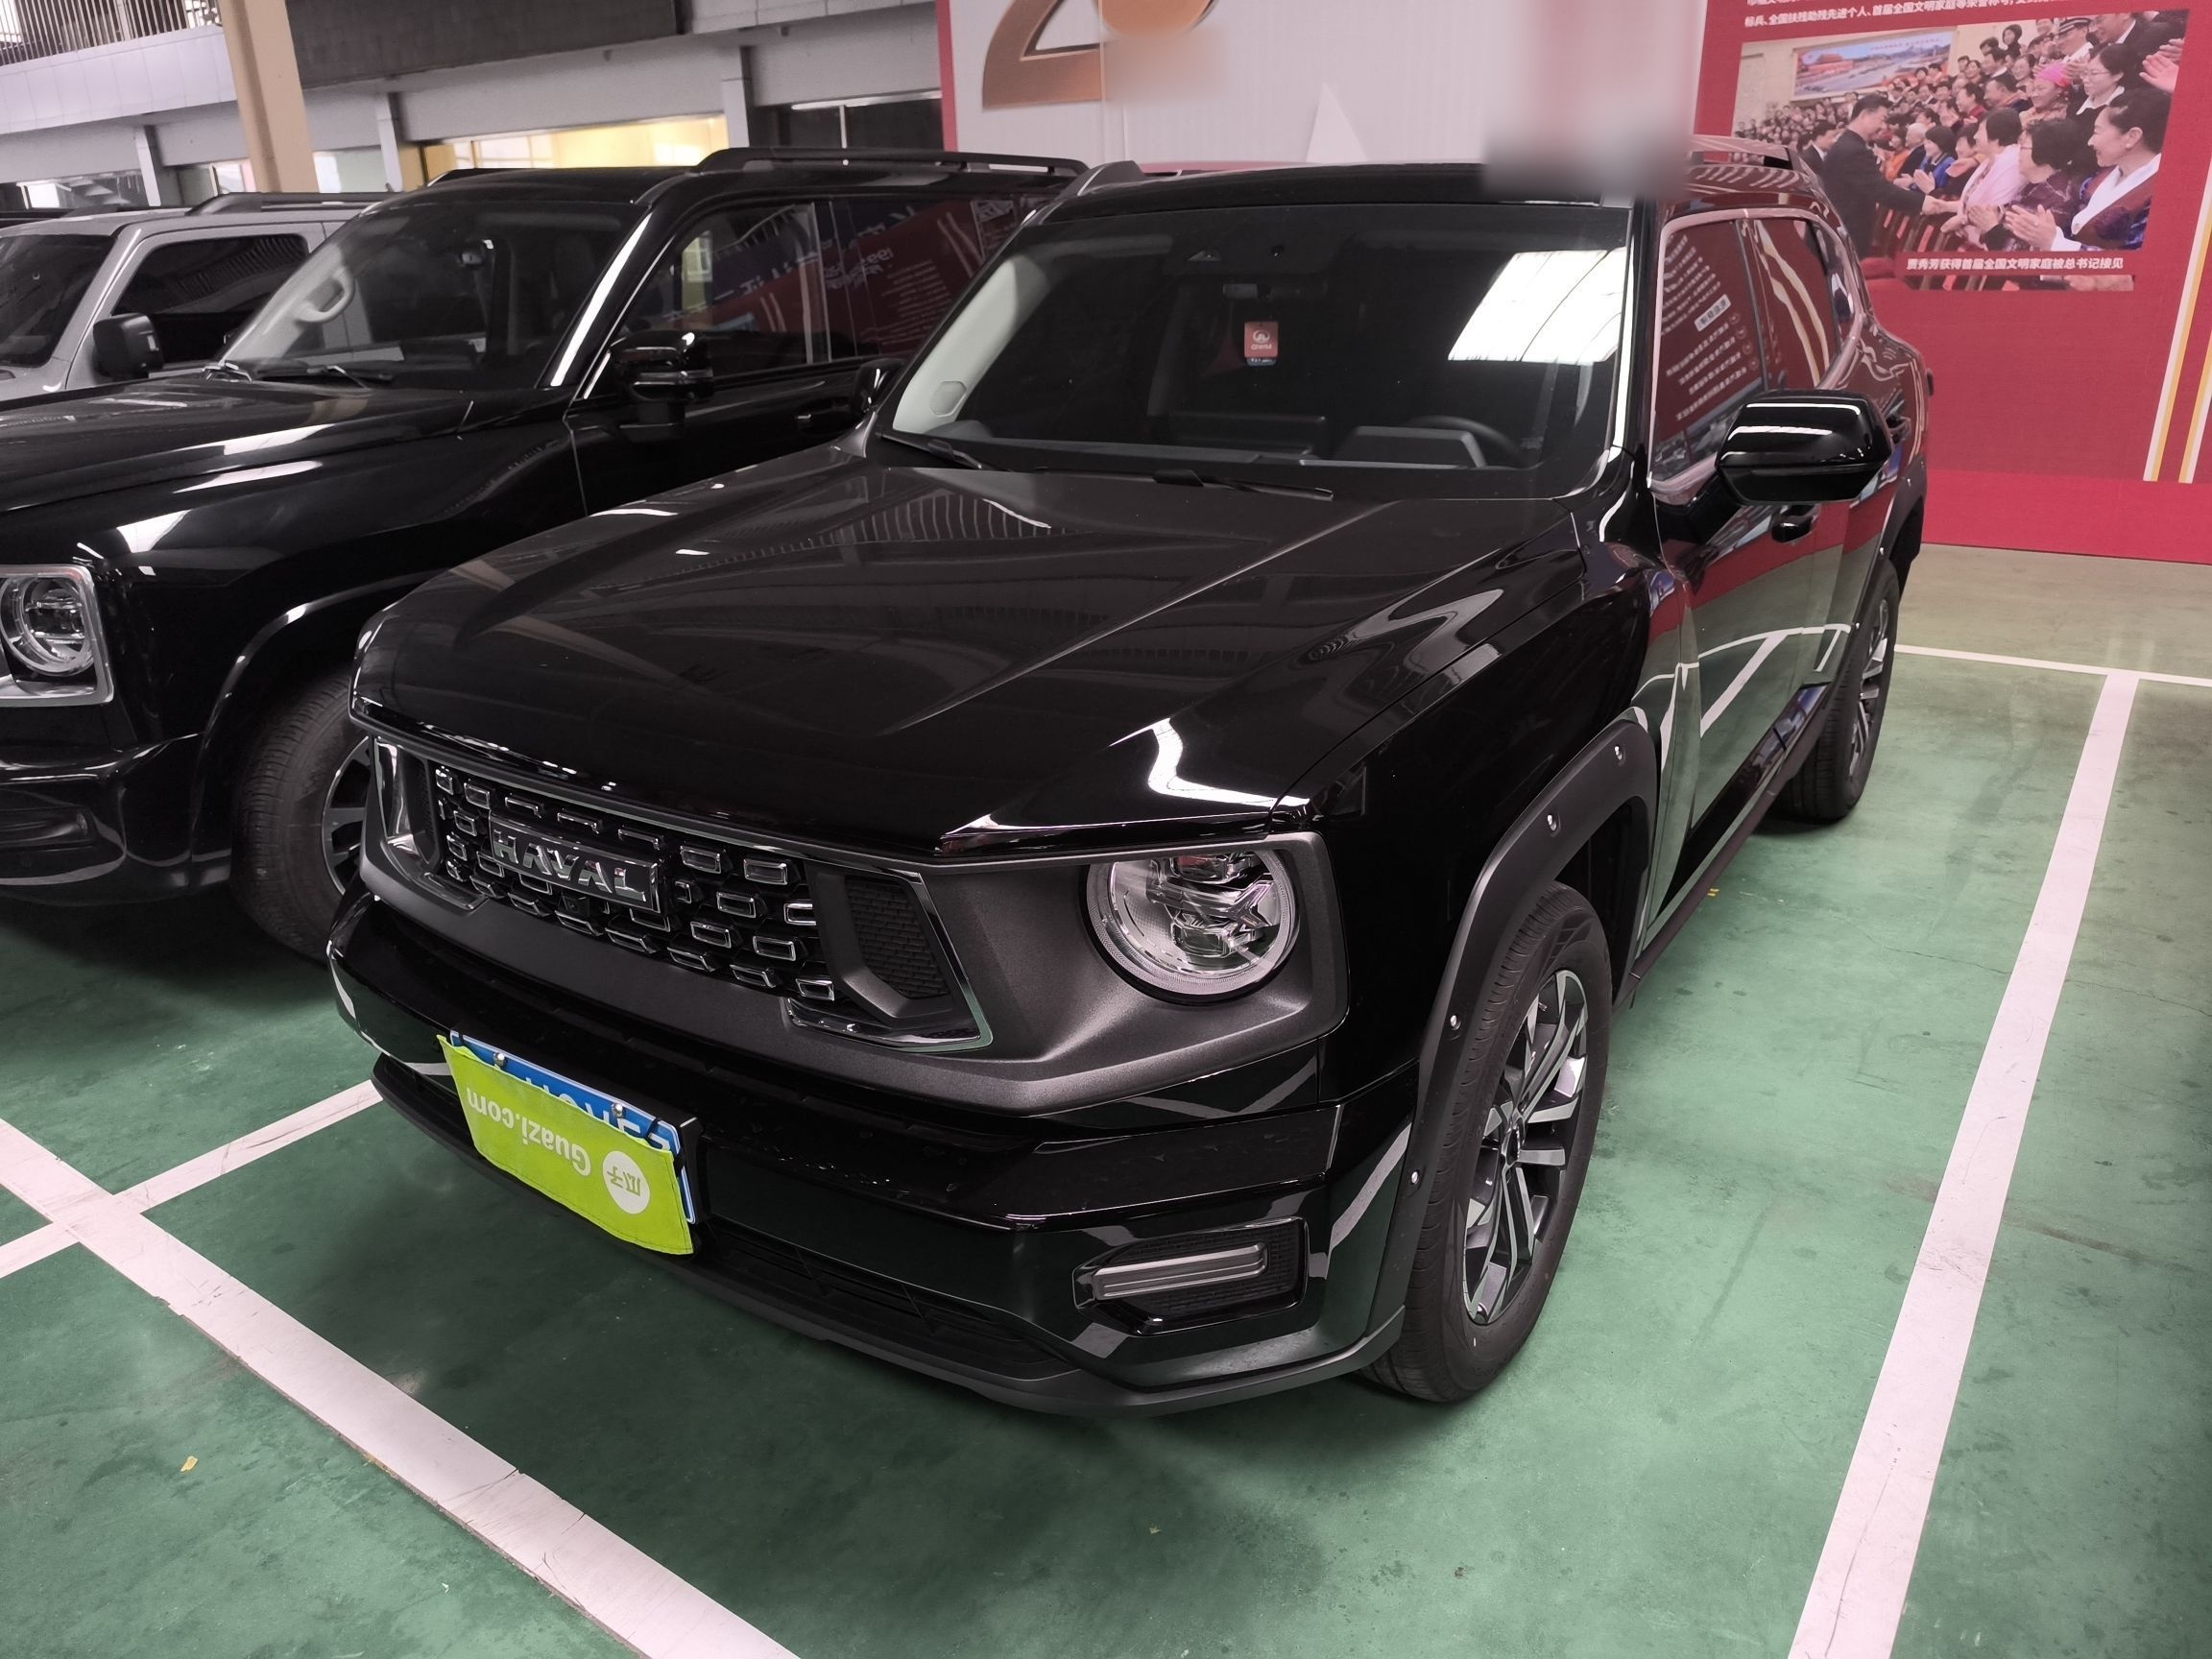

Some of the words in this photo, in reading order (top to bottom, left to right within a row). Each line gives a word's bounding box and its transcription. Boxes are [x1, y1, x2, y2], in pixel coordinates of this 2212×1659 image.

[493, 828, 647, 902] HAVAL
[466, 1086, 591, 1177] Guazi.com
[606, 1165, 641, 1197] 瓜子
